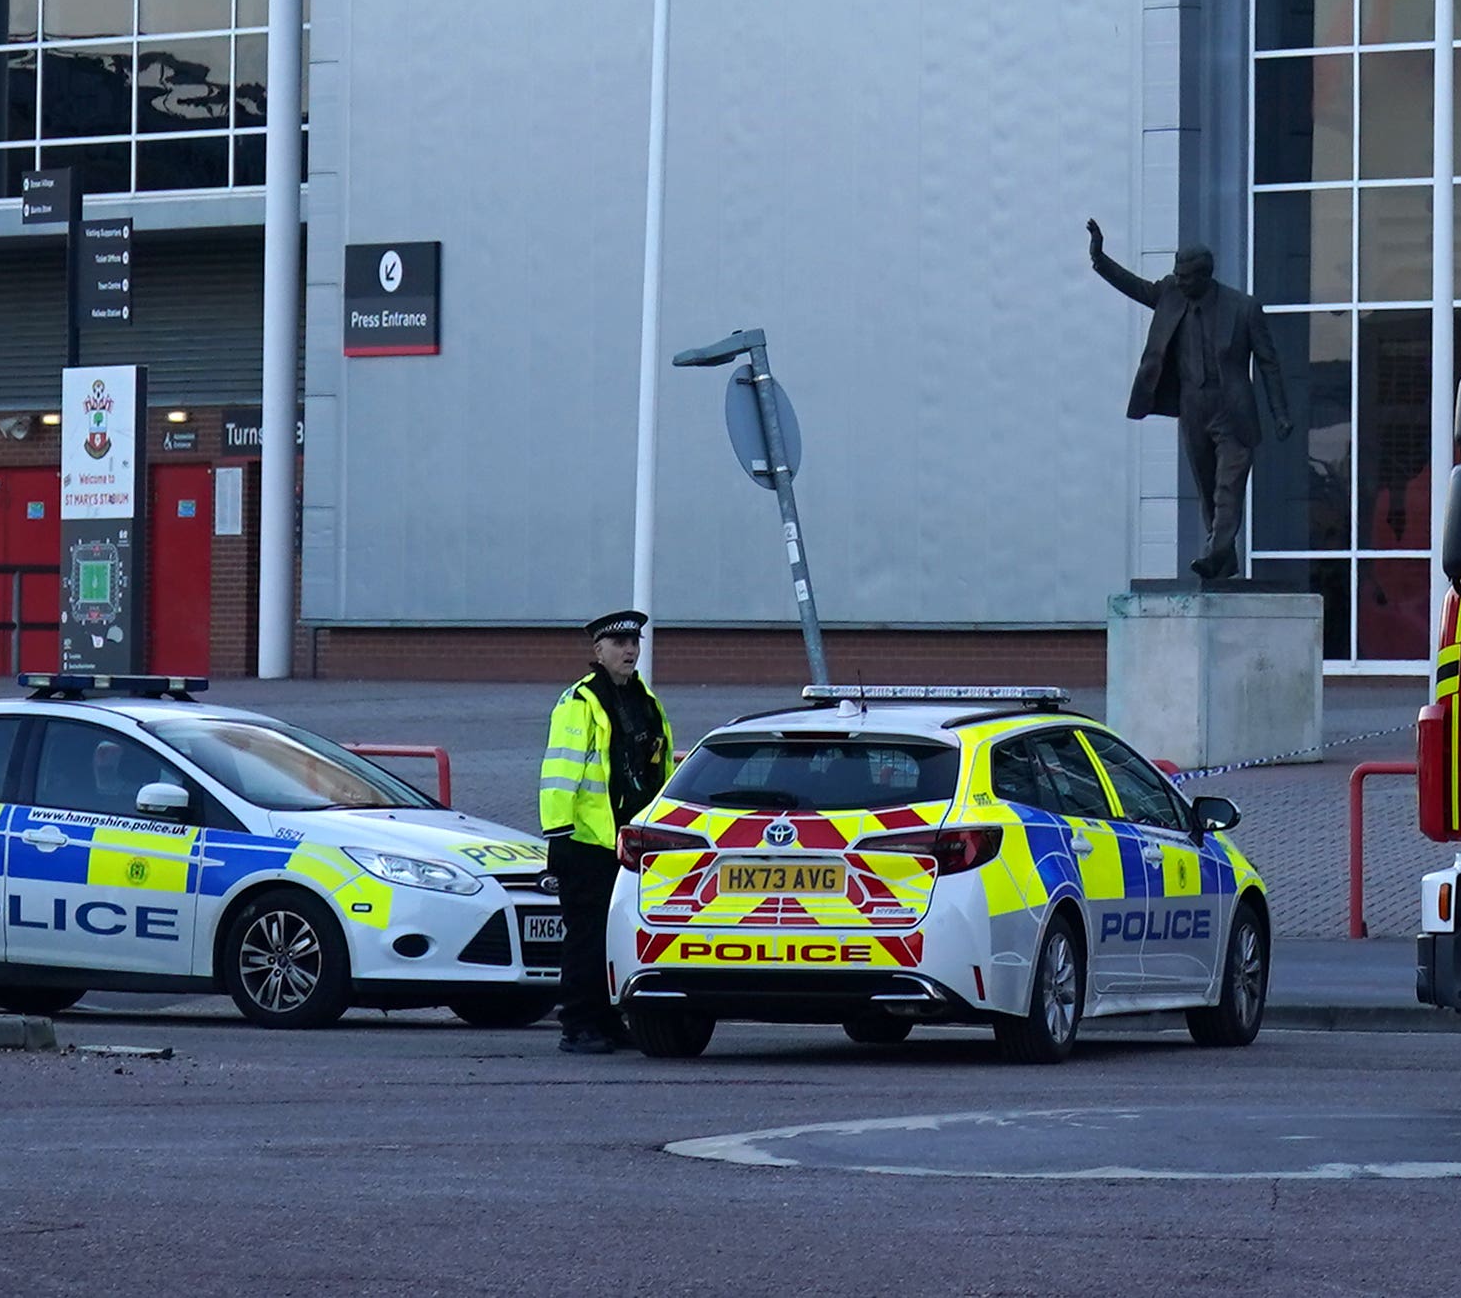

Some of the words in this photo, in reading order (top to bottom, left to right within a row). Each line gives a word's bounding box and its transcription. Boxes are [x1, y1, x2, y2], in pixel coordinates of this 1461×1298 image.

[351, 310, 380, 328] Press
[382, 309, 427, 327] Entrance
[226, 423, 264, 445] Turns
[79, 474, 107, 485] Welcome
[109, 474, 115, 484] to
[65, 494, 73, 505] ST
[99, 492, 128, 505] STADIUM
[31, 810, 189, 836] www.hampshire.police.uk
[460, 844, 548, 867] POLI
[729, 868, 786, 890] HX73
[793, 869, 836, 889] AVG
[529, 918, 563, 938] HX64
[1100, 910, 1212, 943] POLICE
[680, 943, 872, 962] POLICE
